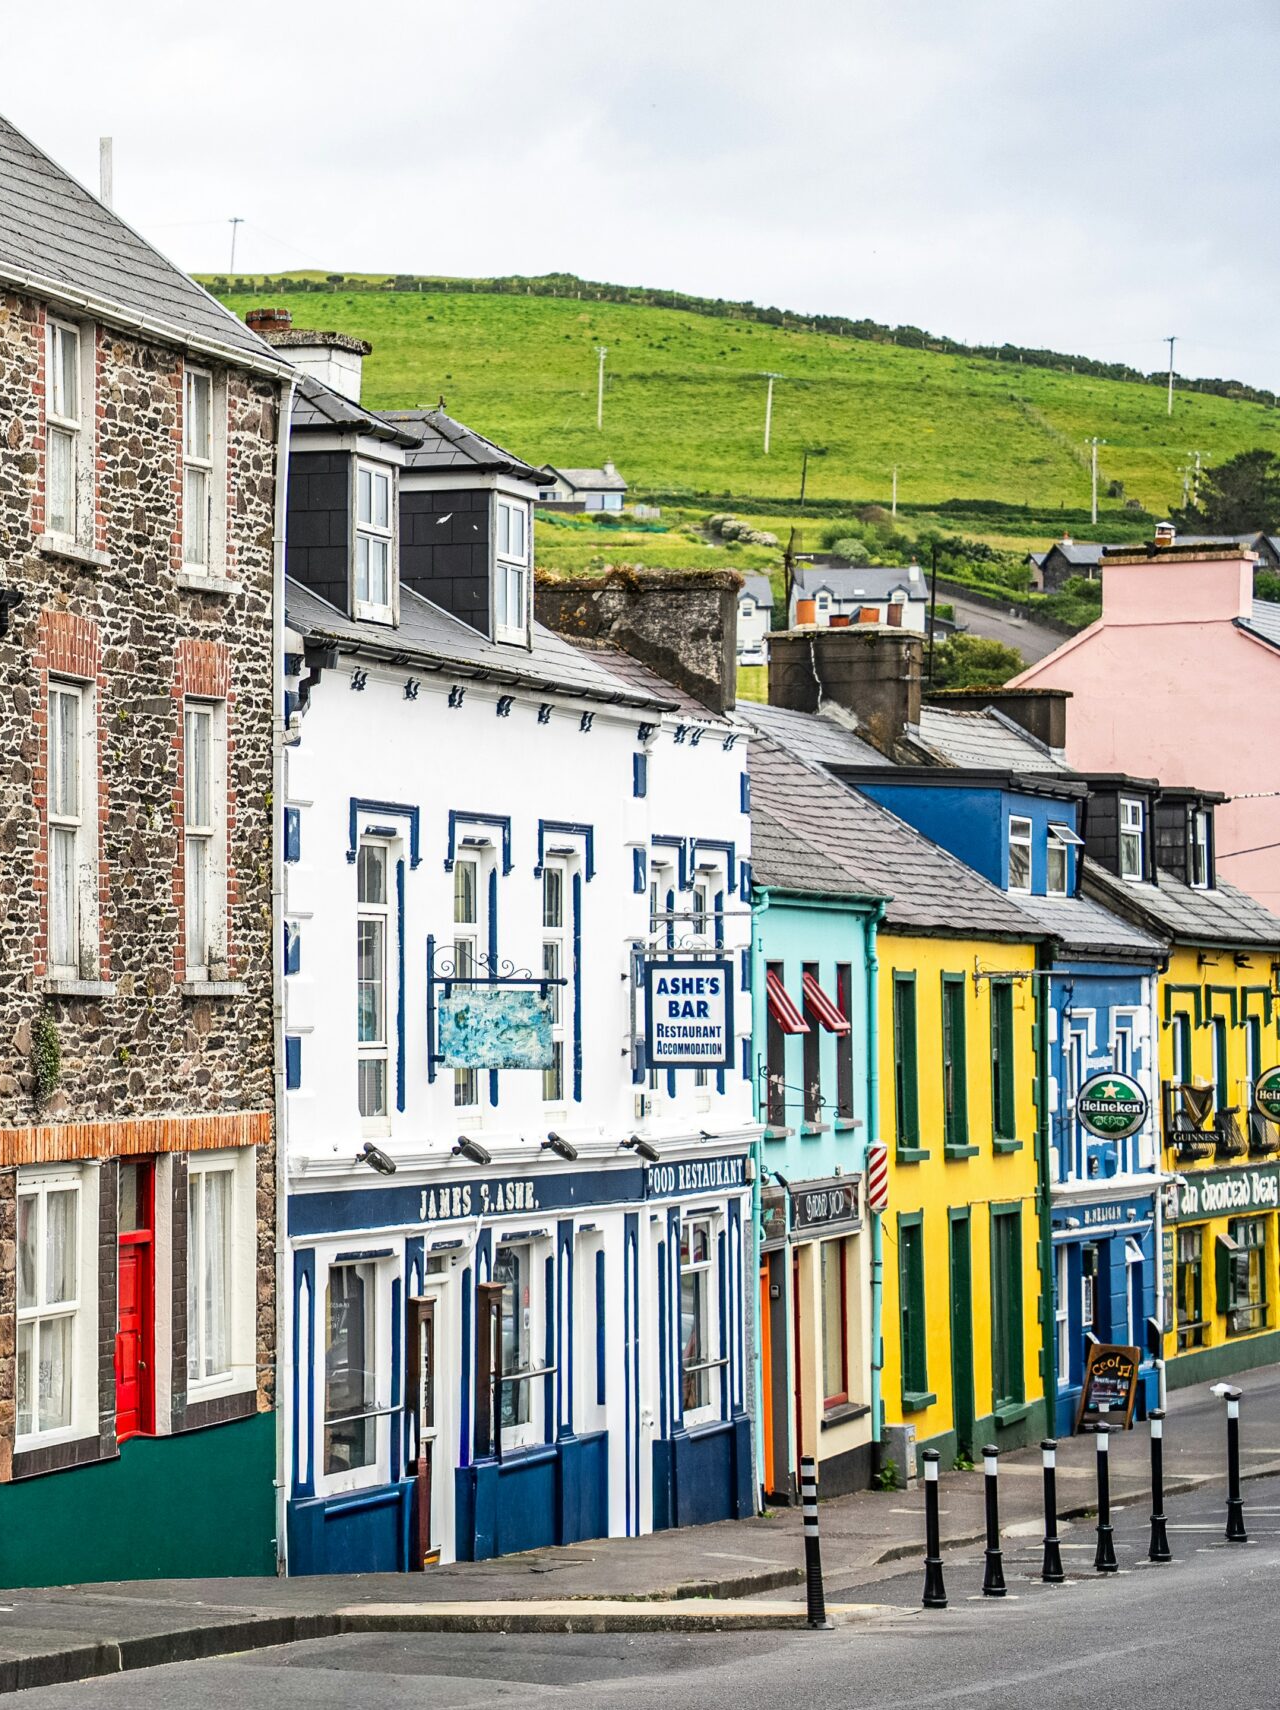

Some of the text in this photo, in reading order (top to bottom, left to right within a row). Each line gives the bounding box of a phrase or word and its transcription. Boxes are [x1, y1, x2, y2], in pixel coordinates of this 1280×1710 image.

[656, 977, 720, 995] ASHE'S
[668, 1000, 709, 1018] BAR
[656, 1023, 722, 1038] RESTAURANT
[656, 1040, 722, 1055] ACCOMMODATION
[1082, 1100, 1141, 1113] Heineken
[1173, 1131, 1220, 1142] GUINNESS
[678, 1158, 743, 1190] RESTAURANT
[420, 1186, 472, 1221] JAMES
[1091, 1355, 1120, 1376] Ceol
